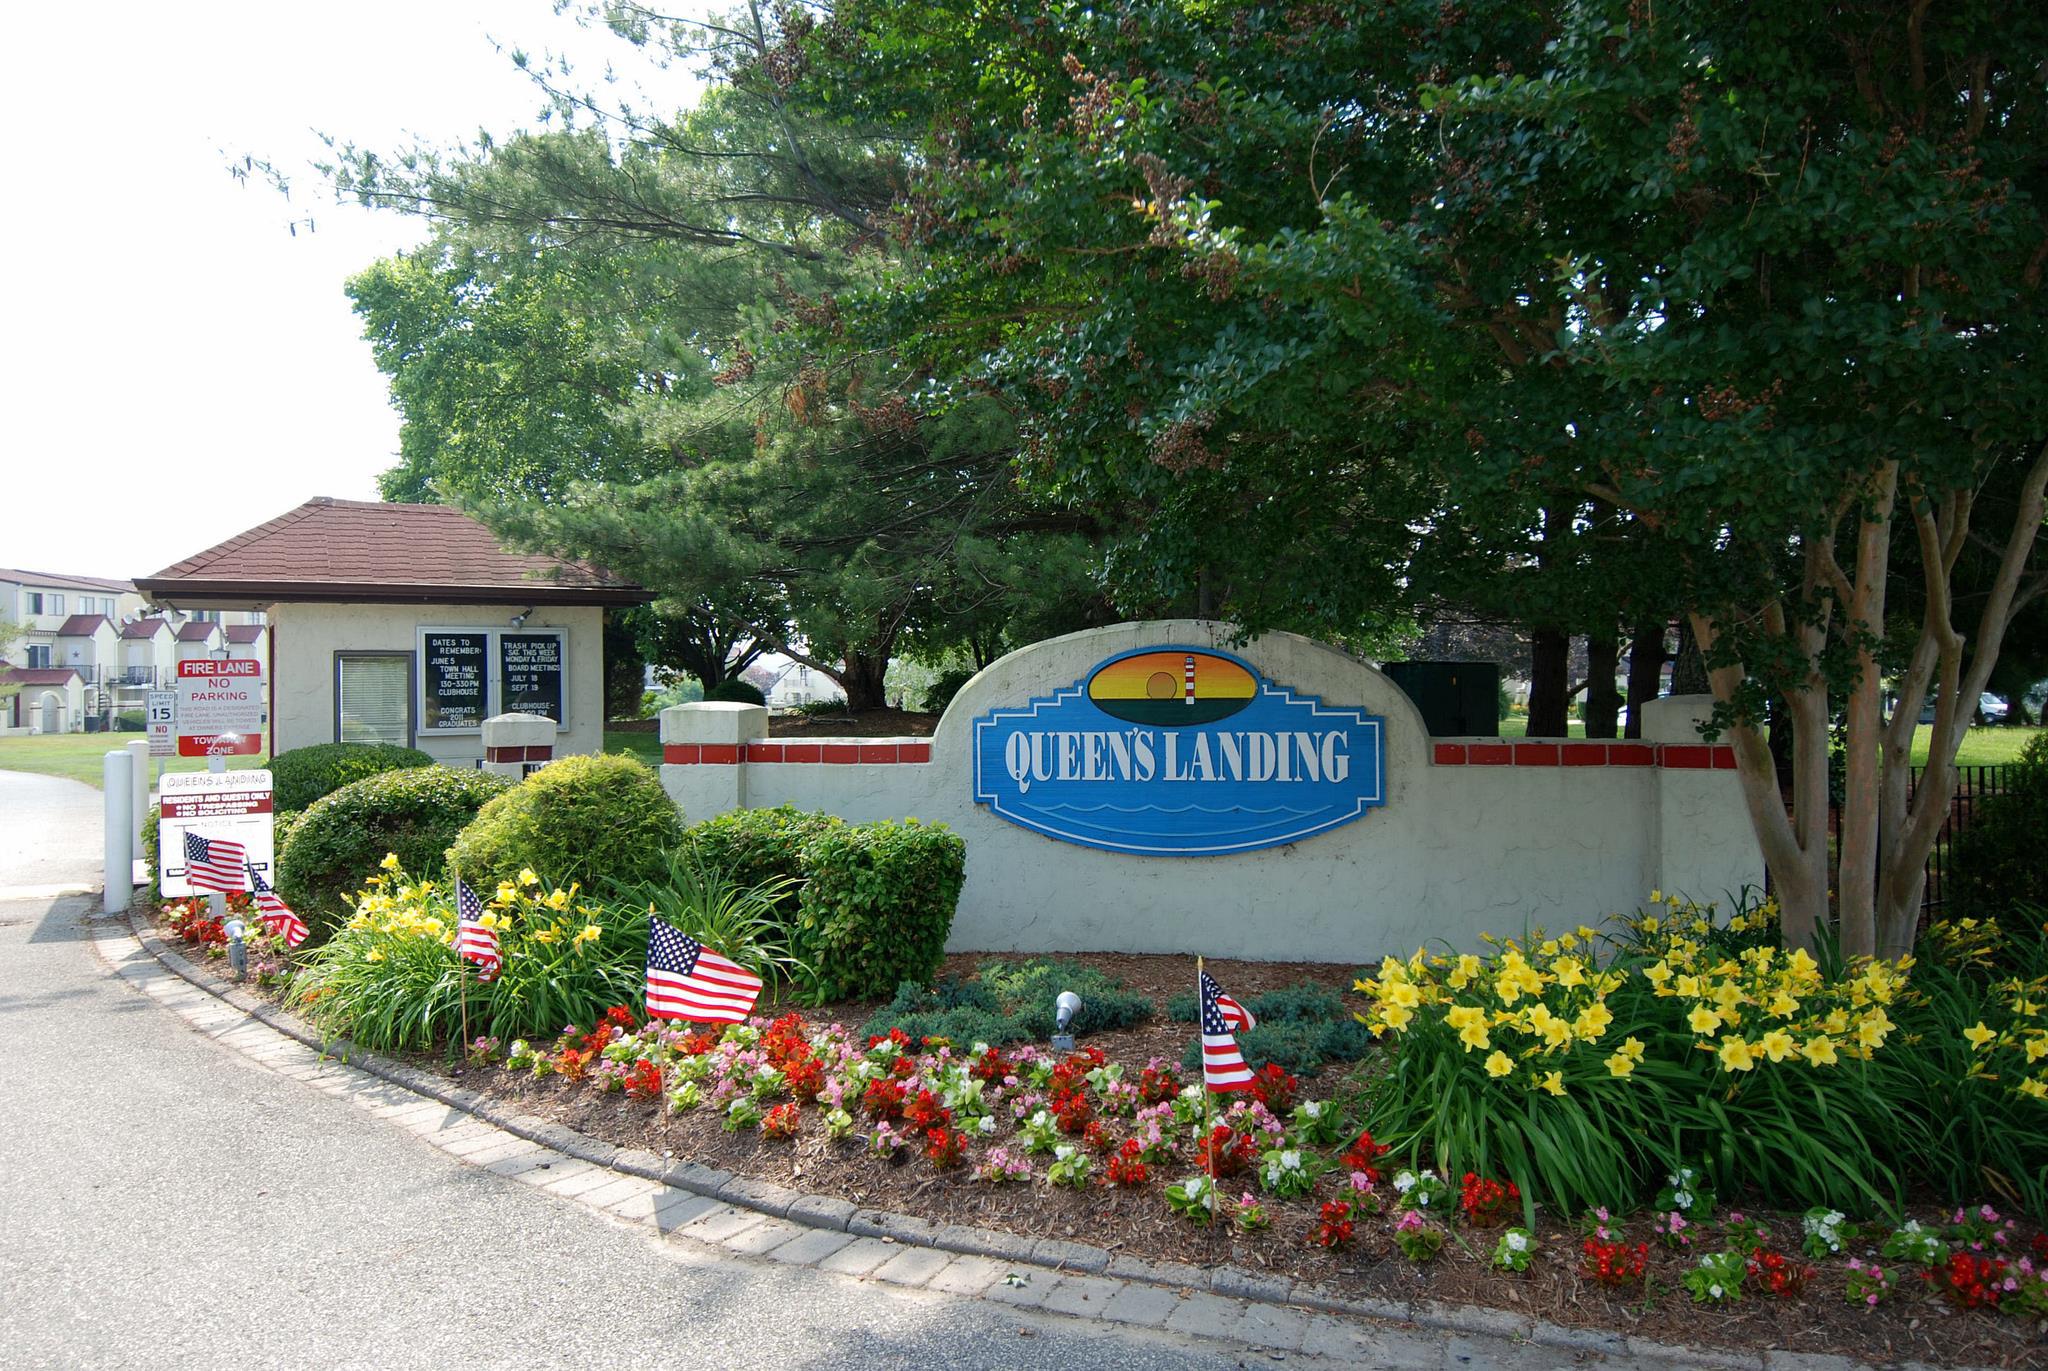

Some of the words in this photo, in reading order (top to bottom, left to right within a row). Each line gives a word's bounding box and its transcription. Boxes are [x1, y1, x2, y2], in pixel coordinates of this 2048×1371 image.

[431, 657, 449, 665] JUNE
[184, 662, 214, 674] FIRE
[217, 661, 254, 674] LANE
[440, 665, 459, 673] TOWN
[462, 665, 479, 673] HALL
[508, 664, 529, 672] BOARD
[530, 664, 560, 672] MEETINGS
[445, 672, 475, 680] MEETING
[511, 674, 527, 682] JULY
[208, 678, 231, 689] NO
[191, 691, 248, 701] PARKING
[439, 688, 478, 696] CLUBHOUSE
[152, 708, 171, 720] 15
[441, 706, 476, 714] CONGRATS
[155, 725, 168, 733] NO
[206, 746, 234, 755] ZONE
[1005, 727, 1156, 794] QUEEN'S
[1162, 730, 1350, 783] LANDING
[167, 775, 214, 788] QUEENS
[215, 773, 267, 786] LANDING
[162, 795, 204, 804] RESIDENTS
[205, 794, 221, 802] AND
[221, 793, 250, 801] GUESTS
[250, 791, 270, 800] ONLY
[198, 801, 259, 810] TRESPASSING
[198, 808, 248, 816] SOLICITING
